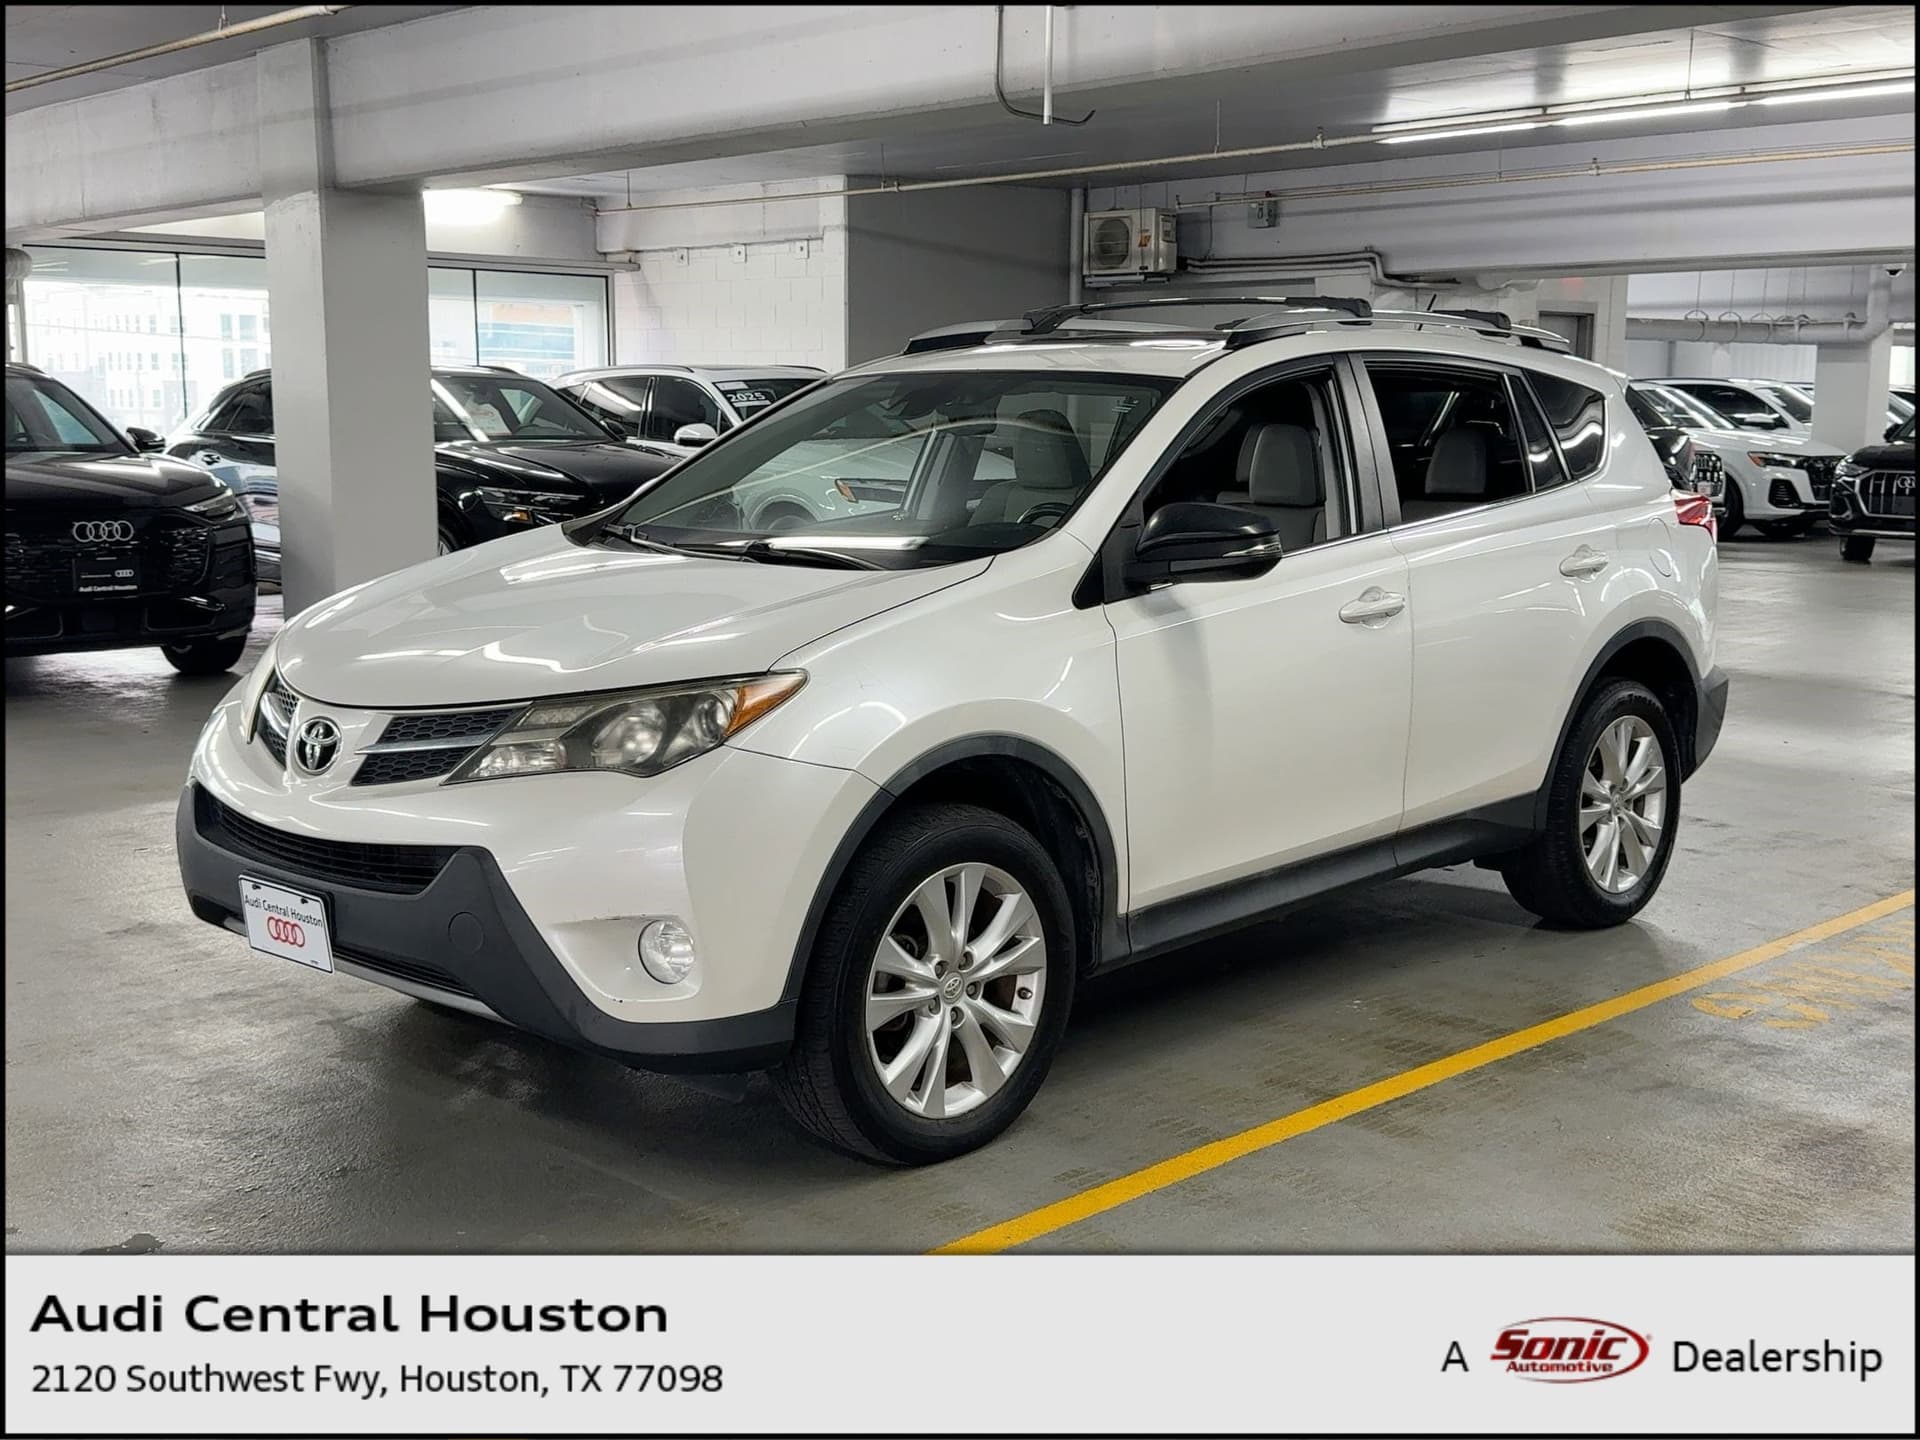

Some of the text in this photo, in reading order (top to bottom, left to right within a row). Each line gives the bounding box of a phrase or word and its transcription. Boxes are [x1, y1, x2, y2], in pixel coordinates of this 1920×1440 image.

[726, 392, 766, 402] 2025
[244, 893, 323, 927] Audi Central Houston
